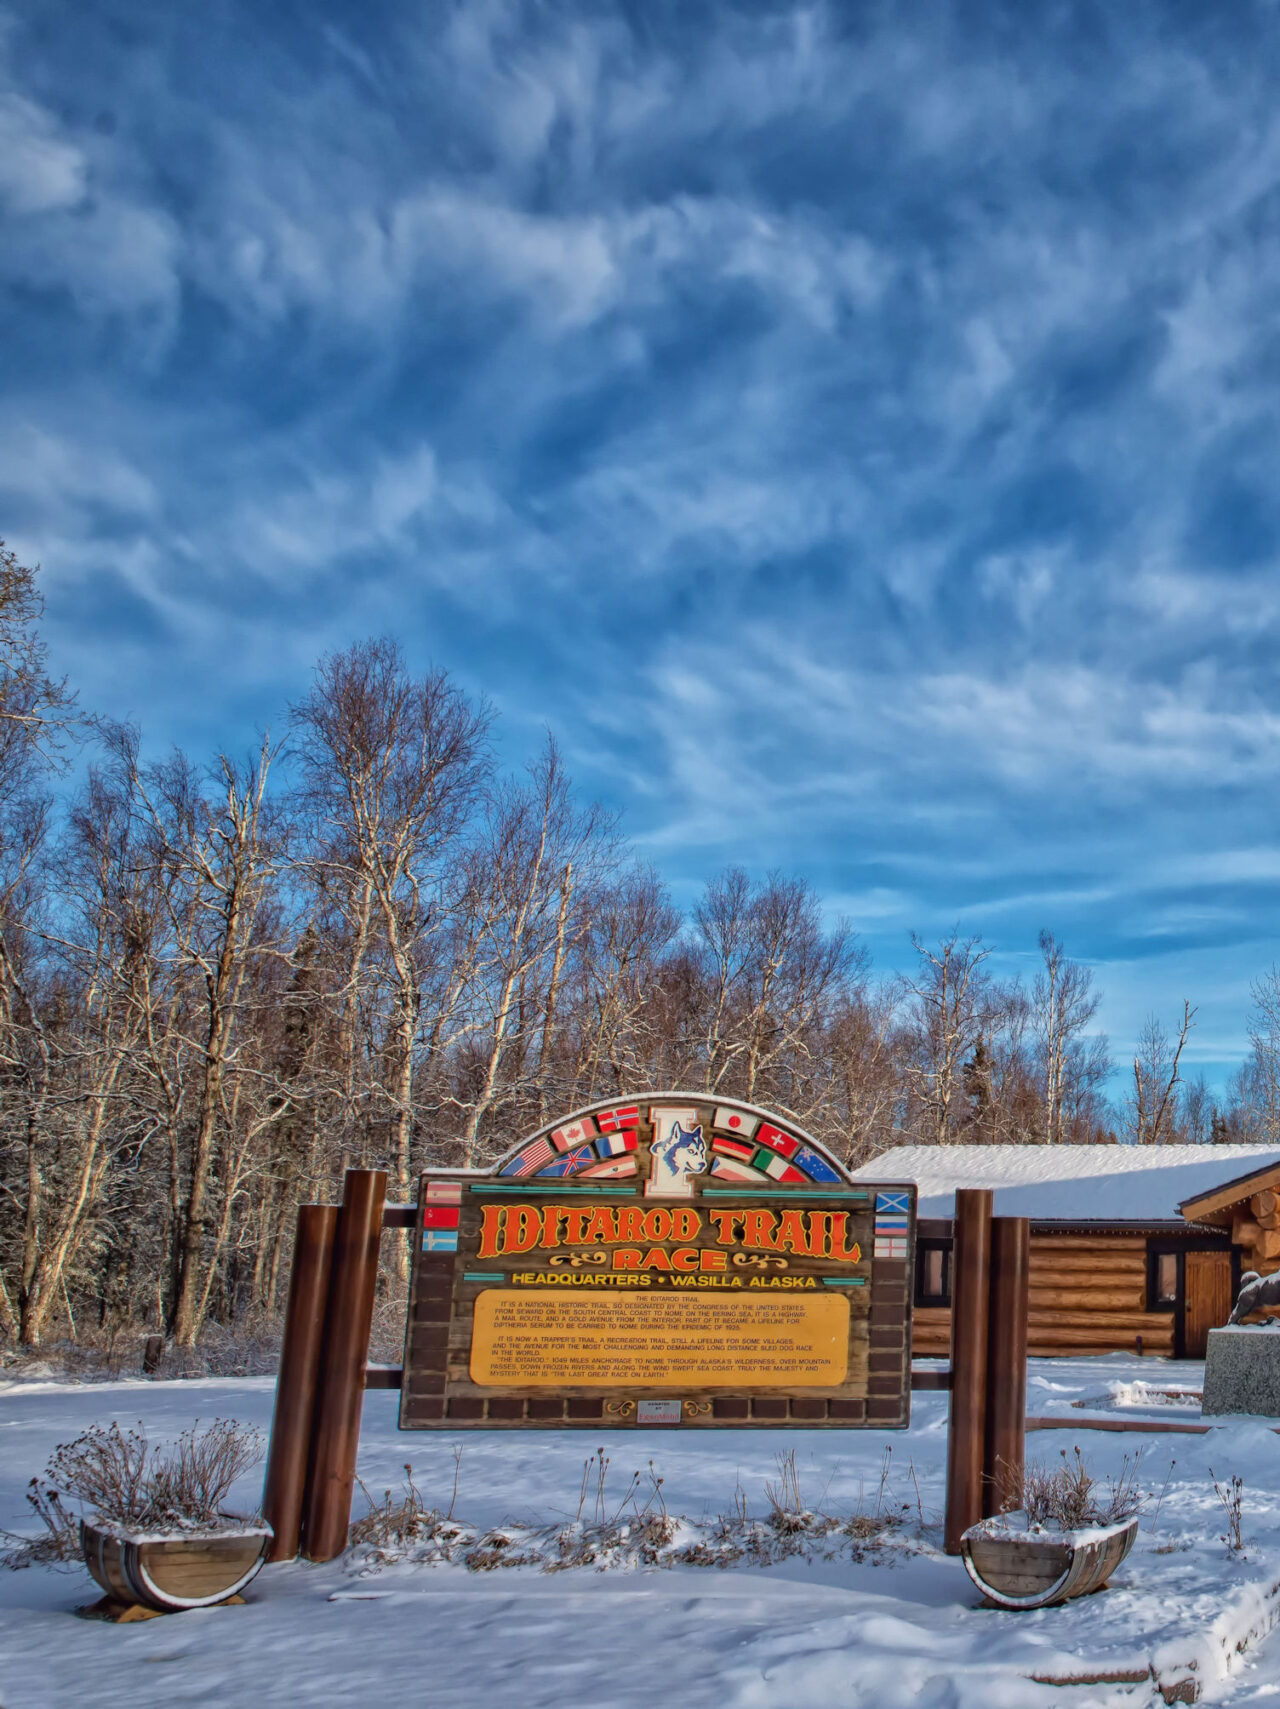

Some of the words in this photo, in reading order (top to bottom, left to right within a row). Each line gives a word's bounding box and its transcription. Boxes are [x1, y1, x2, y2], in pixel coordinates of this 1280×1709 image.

[476, 1204, 702, 1259] IDITAROD
[709, 1208, 862, 1264] TRAIL
[612, 1247, 728, 1272] RACE
[512, 1272, 652, 1286] HEADQUARTERS
[670, 1275, 742, 1287] WASILLA
[749, 1277, 817, 1288] ALASKA
